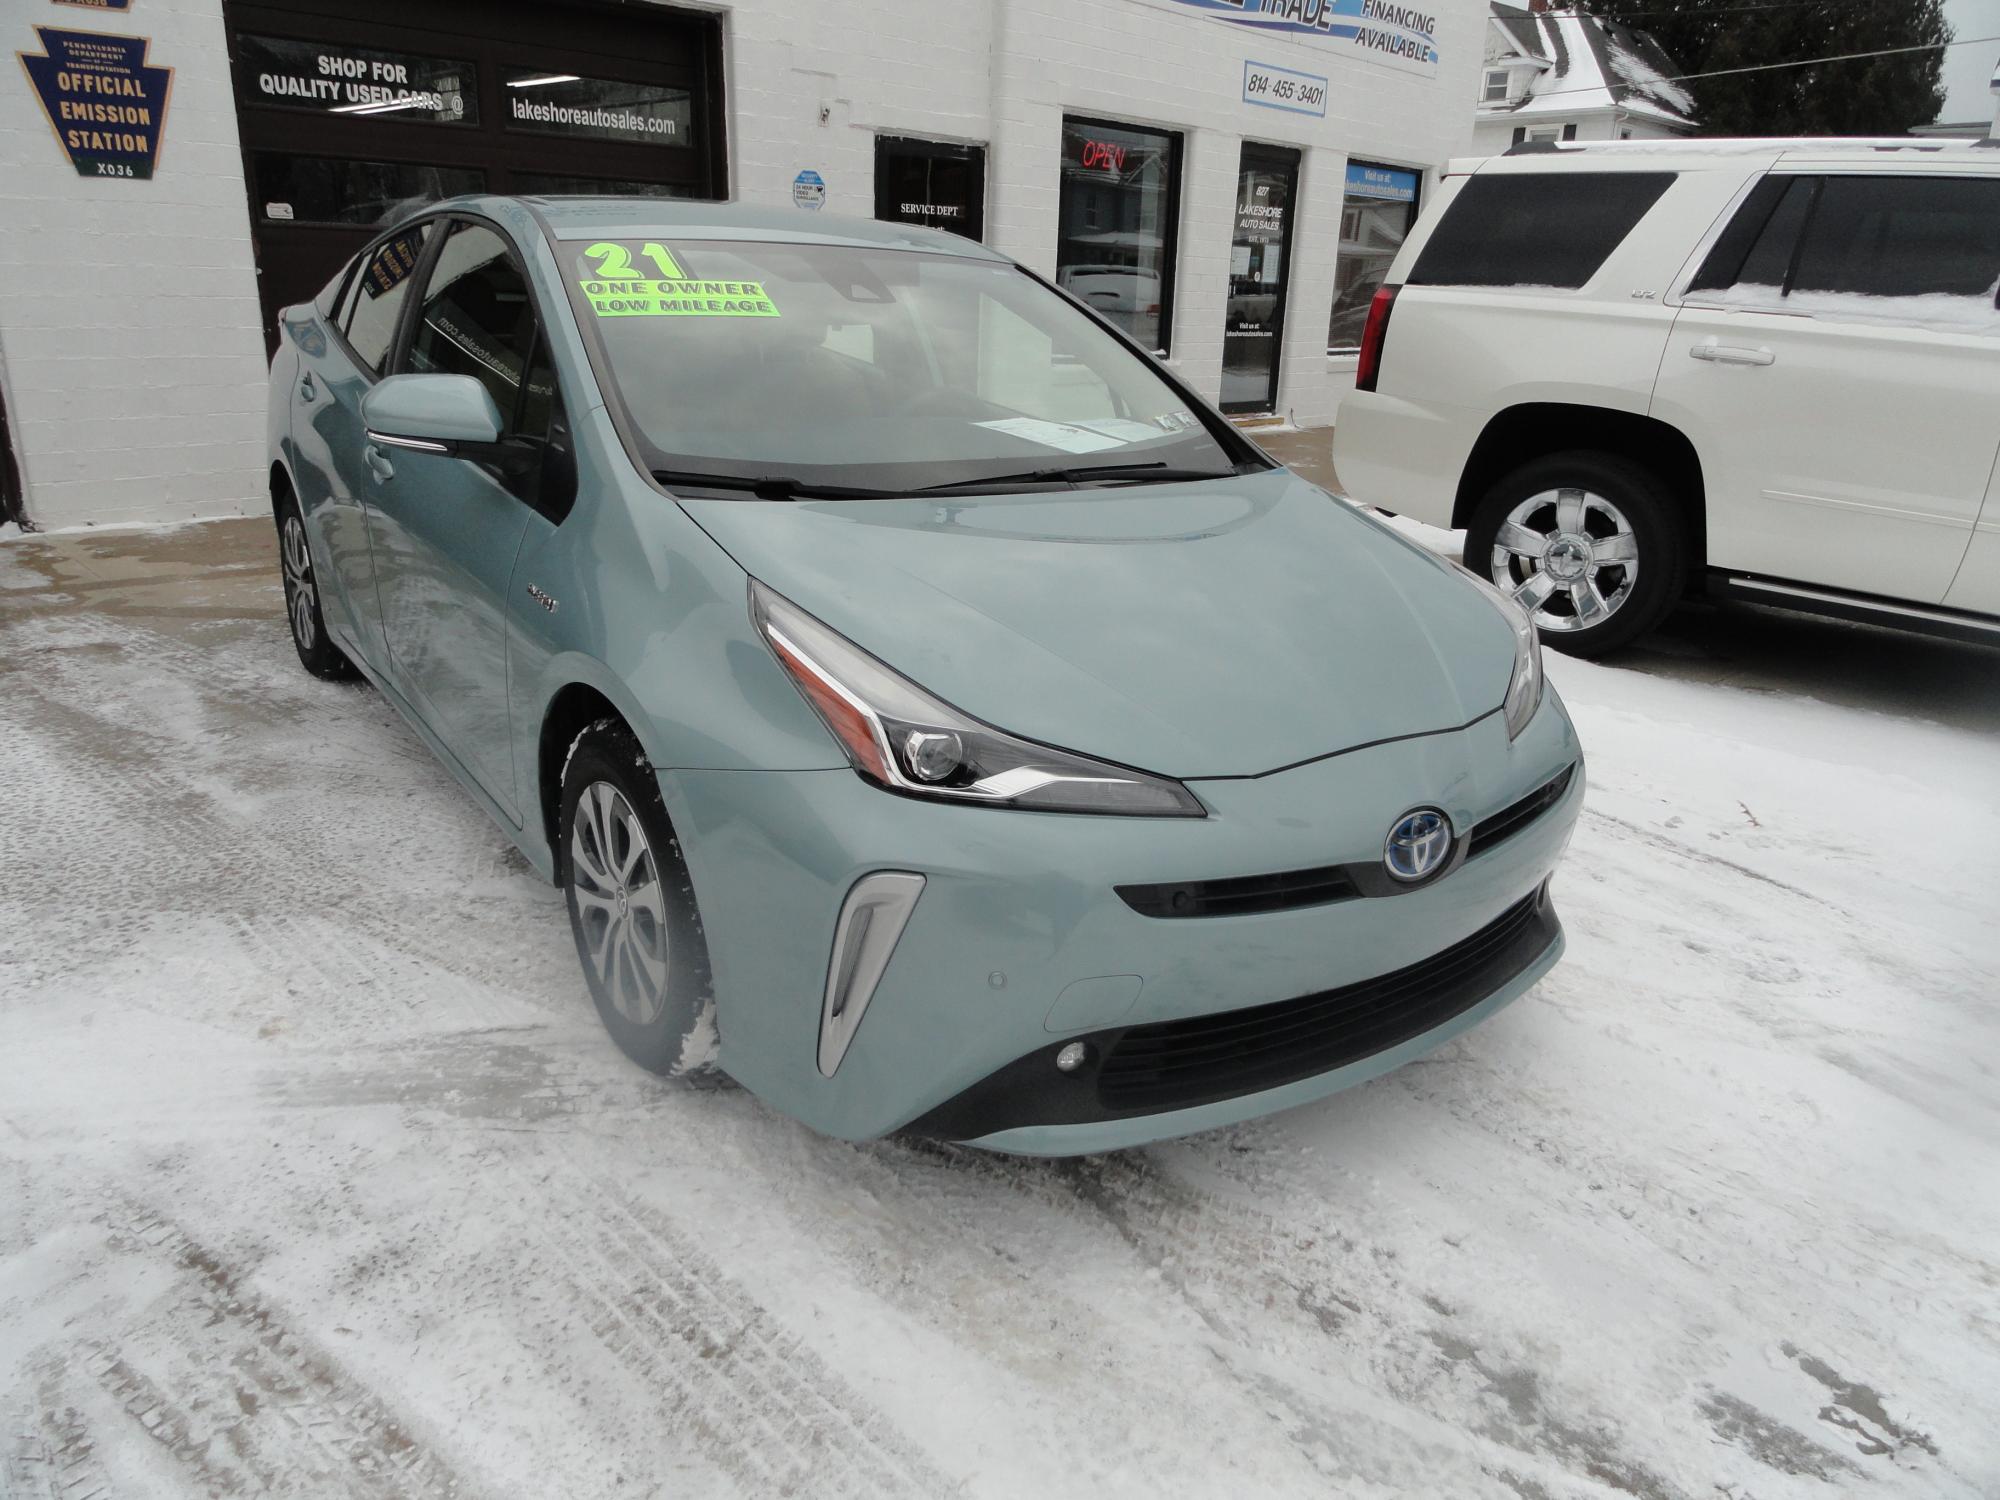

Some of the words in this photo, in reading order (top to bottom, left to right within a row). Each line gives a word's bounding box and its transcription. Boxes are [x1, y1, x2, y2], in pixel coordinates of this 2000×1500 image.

[1362, 0, 1435, 35] FINANCING
[63, 41, 126, 54] PENNSYLVANIA
[69, 49, 122, 60] DEPARTMENT
[1355, 27, 1431, 63] AVAILABLE
[66, 62, 131, 74] TRANSPORTATION
[318, 56, 367, 78] SHOP
[372, 62, 408, 84] FOR
[58, 72, 147, 97] OFFICIAL
[260, 74, 340, 100] QUALITY
[346, 84, 393, 105] USED
[398, 89, 442, 110] CARS
[452, 95, 464, 115] @
[60, 101, 151, 125] EMISSION
[512, 98, 675, 134] lakeshoreautosales.com
[68, 129, 148, 152] STATION
[1083, 140, 1126, 169] OPEN
[97, 162, 134, 177] X036
[900, 203, 936, 215] SERVICE
[936, 205, 959, 217] DEPT
[1238, 203, 1283, 218] LAKESHORE
[1240, 219, 1259, 229] AUTO
[1258, 220, 1280, 231] SALES
[585, 243, 687, 279] 21
[586, 282, 648, 294] ONE
[657, 282, 759, 295] OWNER
[596, 300, 648, 313] LOW
[660, 300, 772, 313] MILEAGE
